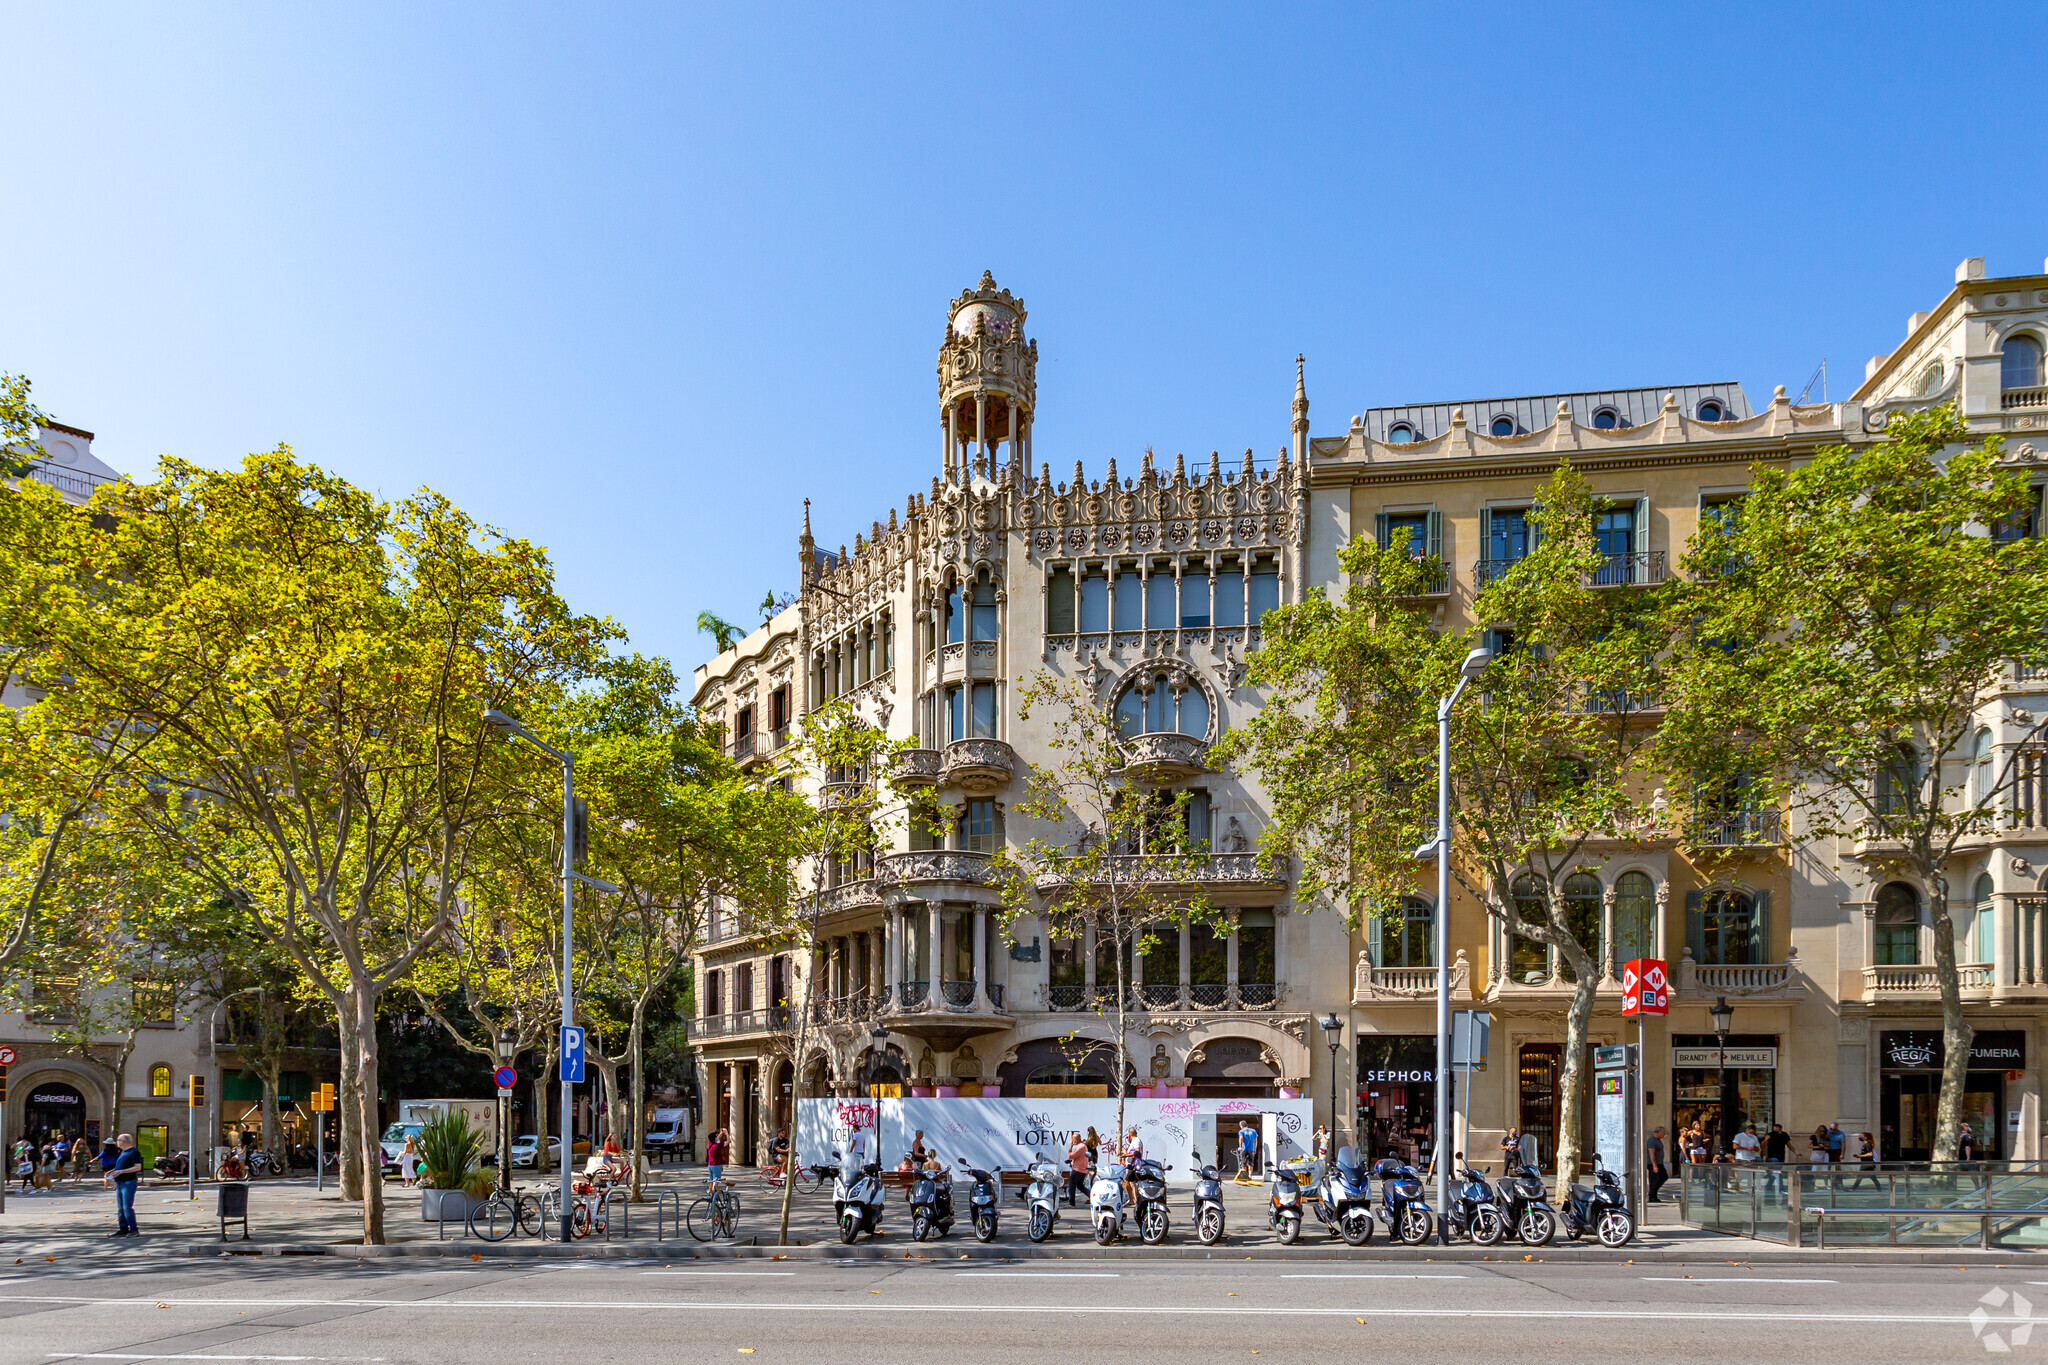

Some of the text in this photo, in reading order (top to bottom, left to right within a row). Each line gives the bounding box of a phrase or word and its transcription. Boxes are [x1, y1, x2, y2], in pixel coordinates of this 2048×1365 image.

[1625, 974, 1632, 987] M
[1652, 972, 1662, 984] M
[565, 1029, 580, 1059] P
[1679, 1053, 1768, 1062] BRANDY MELVILLE
[1891, 1050, 1931, 1063] REGIA
[33, 1094, 79, 1104] Safestay
